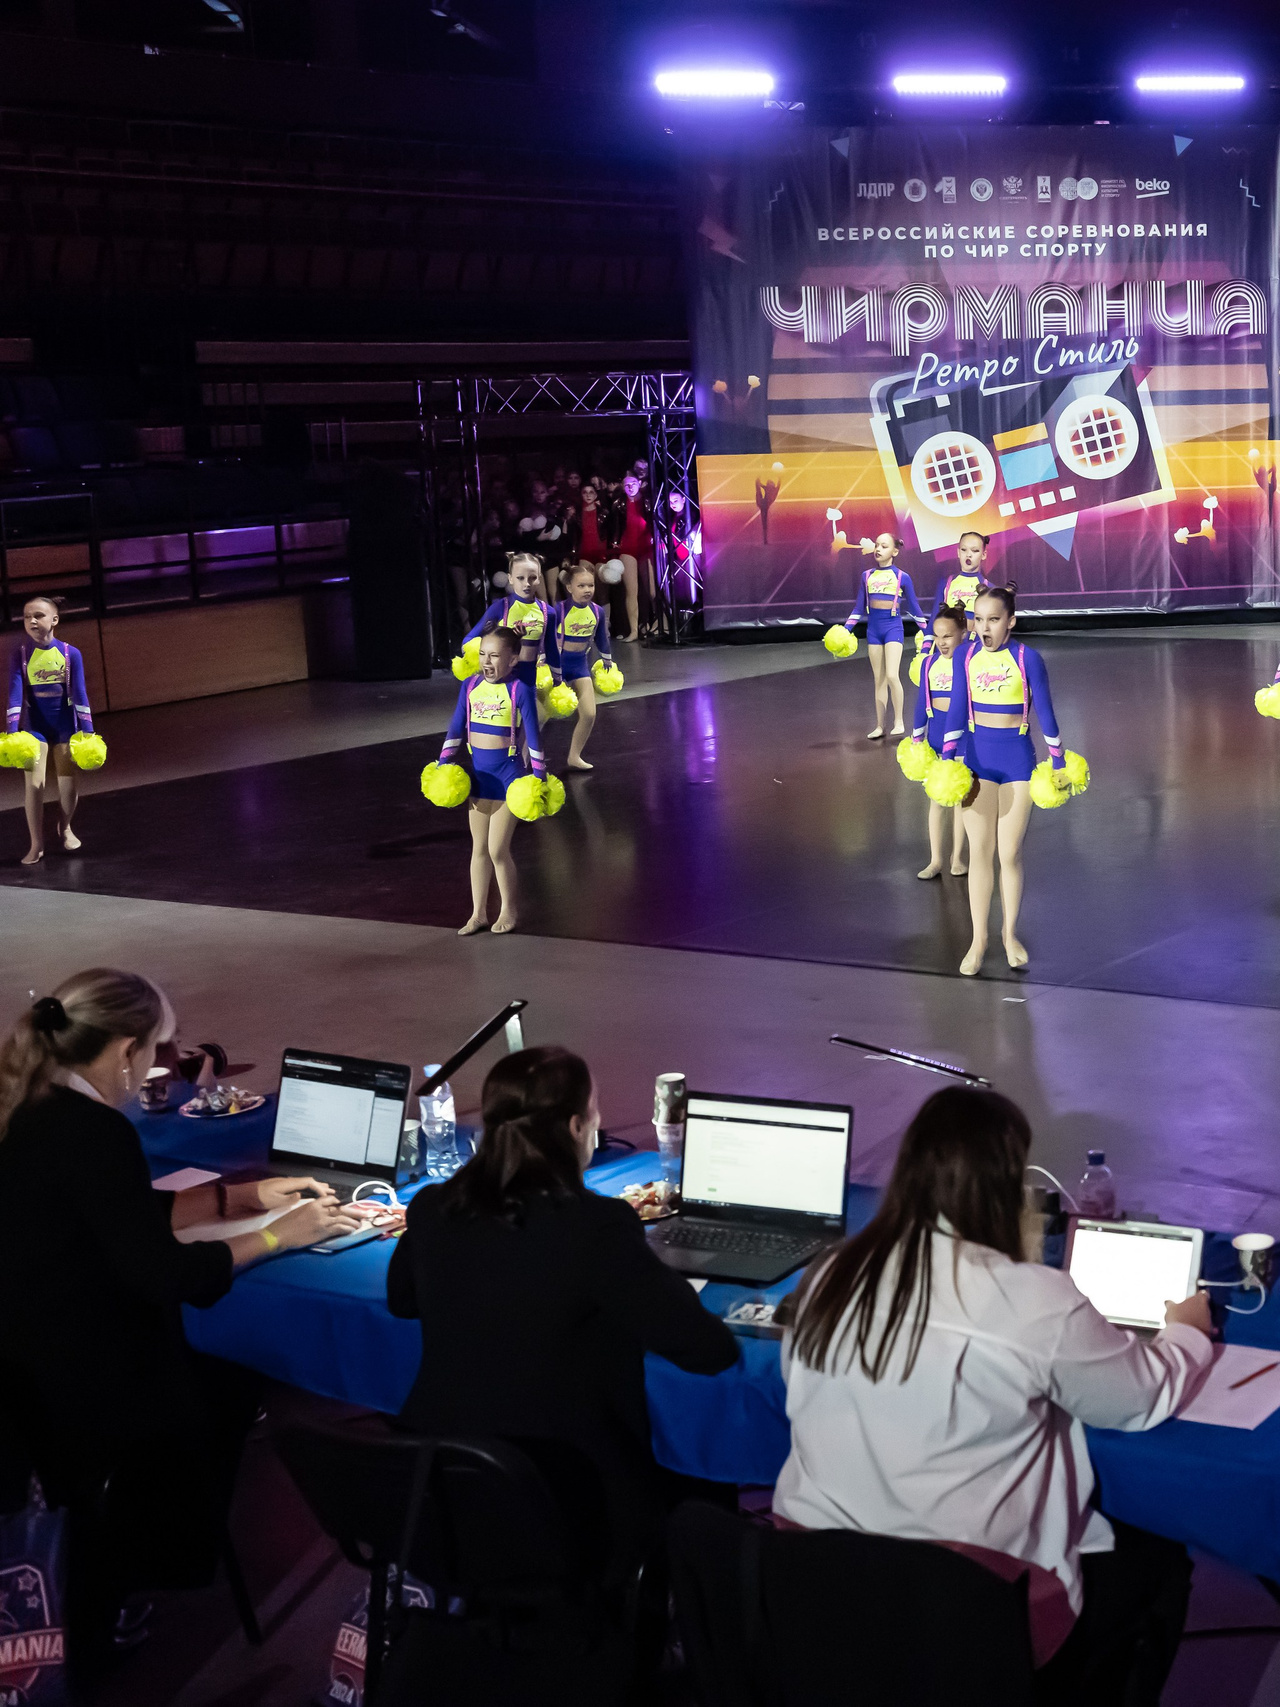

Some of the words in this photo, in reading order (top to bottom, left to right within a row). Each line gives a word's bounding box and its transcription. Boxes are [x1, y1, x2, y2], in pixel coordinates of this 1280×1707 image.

[857, 182, 895, 199] ЛДПР
[1135, 178, 1171, 191] beko
[817, 224, 1016, 241] ВСЕРОССИЙСКИЕ
[1026, 223, 1208, 240] СОРЕВНОВАНИЯ
[924, 244, 954, 259] ПО
[964, 244, 1009, 258] ЧИР
[1020, 243, 1107, 258] СПОРТУ
[912, 352, 1019, 395] Ретро
[1034, 334, 1139, 376] Стиль
